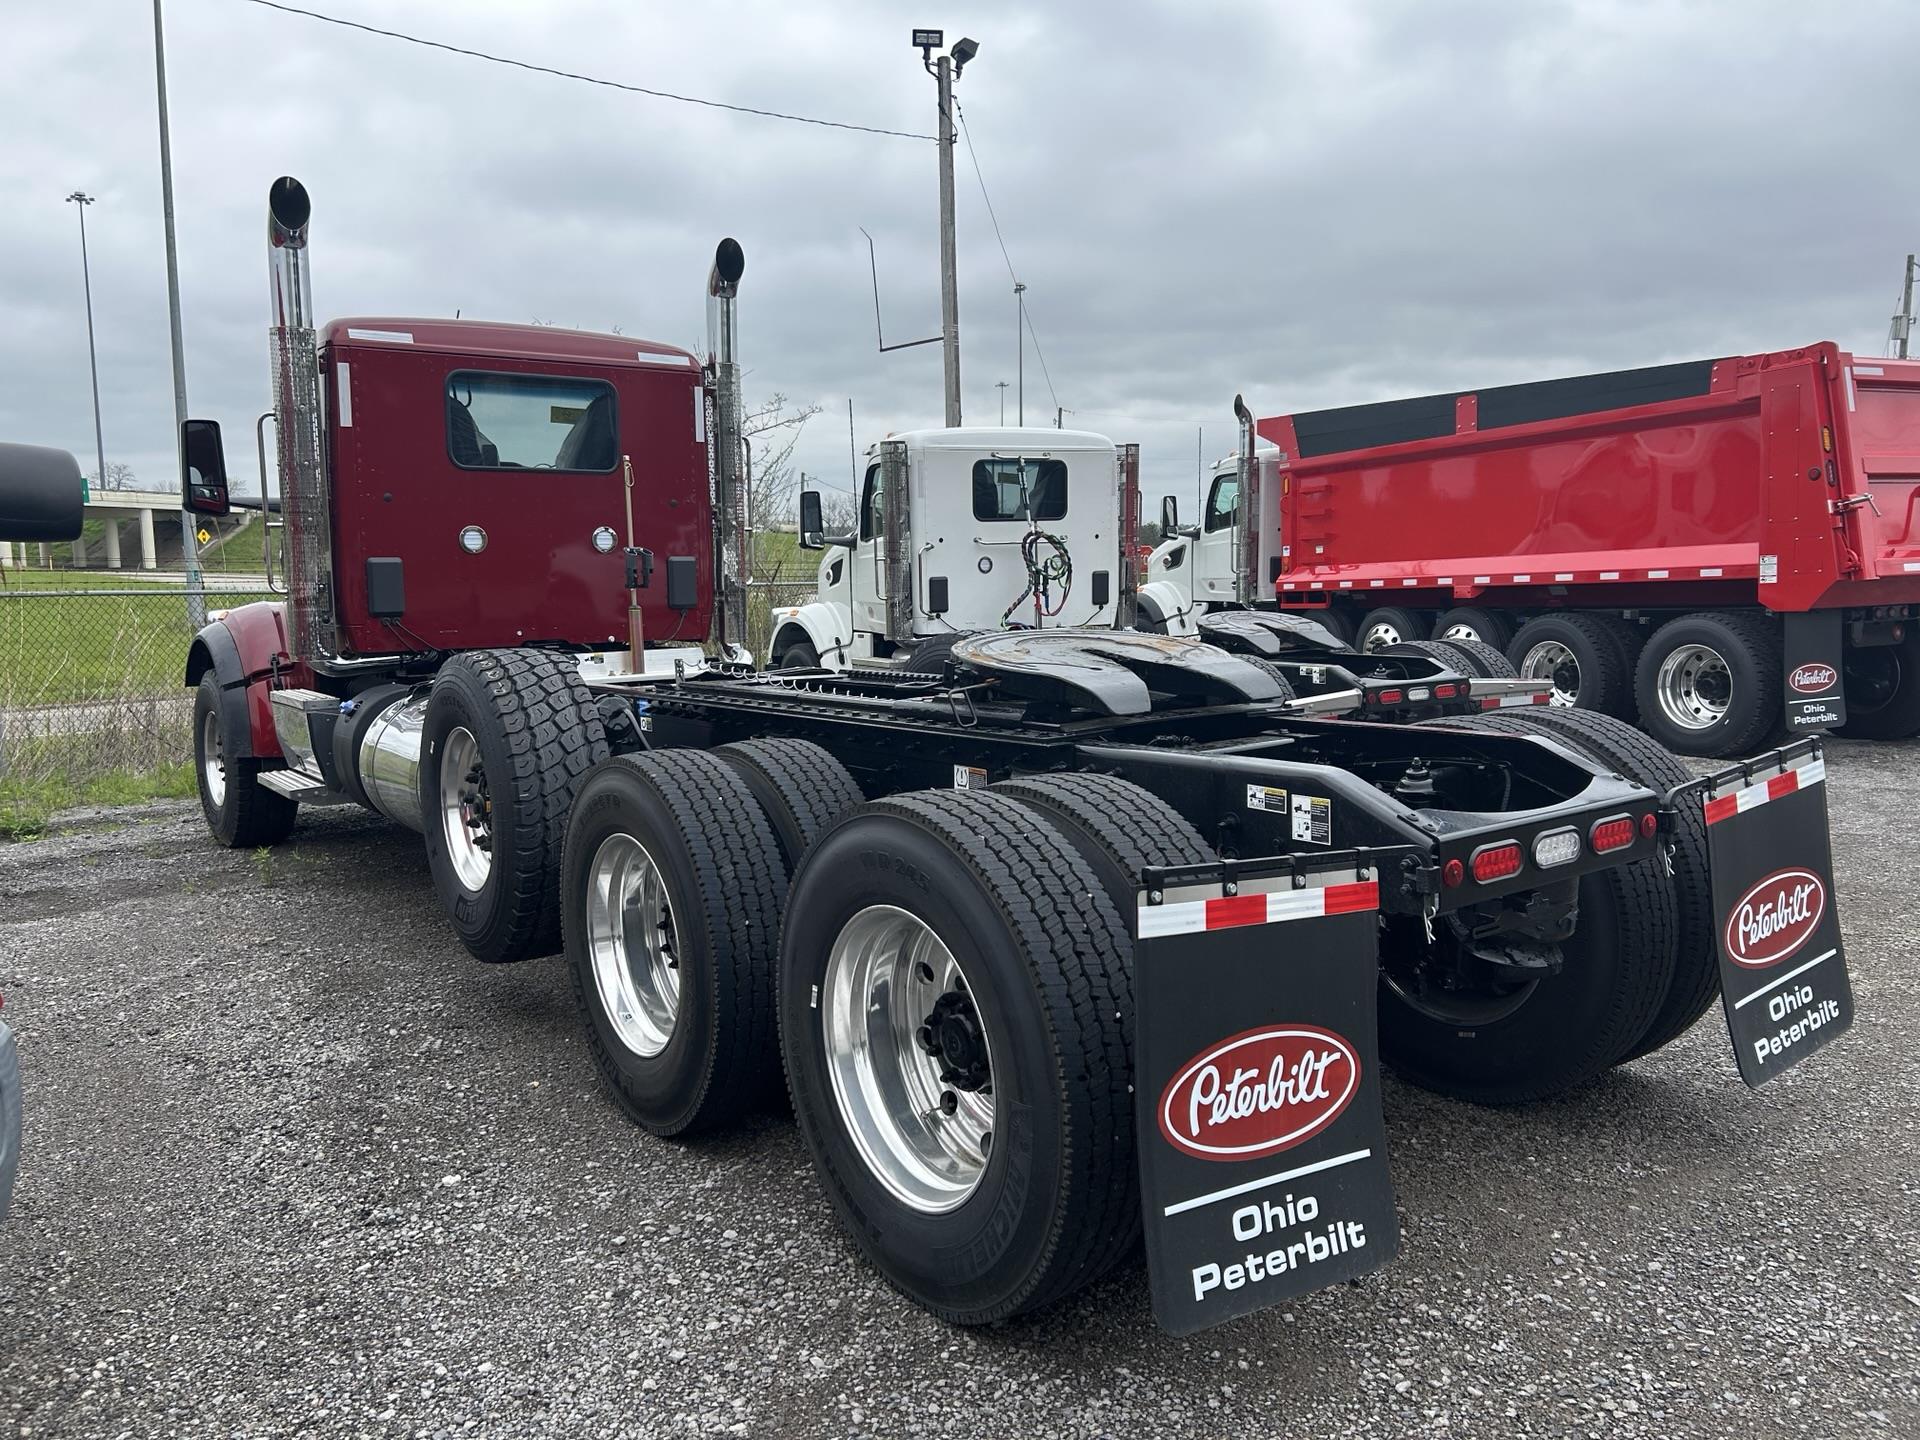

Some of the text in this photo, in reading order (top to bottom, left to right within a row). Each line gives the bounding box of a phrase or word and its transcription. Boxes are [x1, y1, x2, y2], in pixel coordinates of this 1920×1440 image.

[1795, 670, 1833, 687] Peterbilt
[1794, 713, 1838, 725] Peterbilt
[1803, 704, 1826, 714] Ohio
[1738, 884, 1815, 954] Peterbilt
[1768, 985, 1813, 1022] Ohio
[1753, 999, 1840, 1065] Peterbilt
[1189, 1049, 1341, 1137] Peterbilt
[1231, 1193, 1319, 1243] Ohio
[1191, 1220, 1367, 1302] Peterbilt
